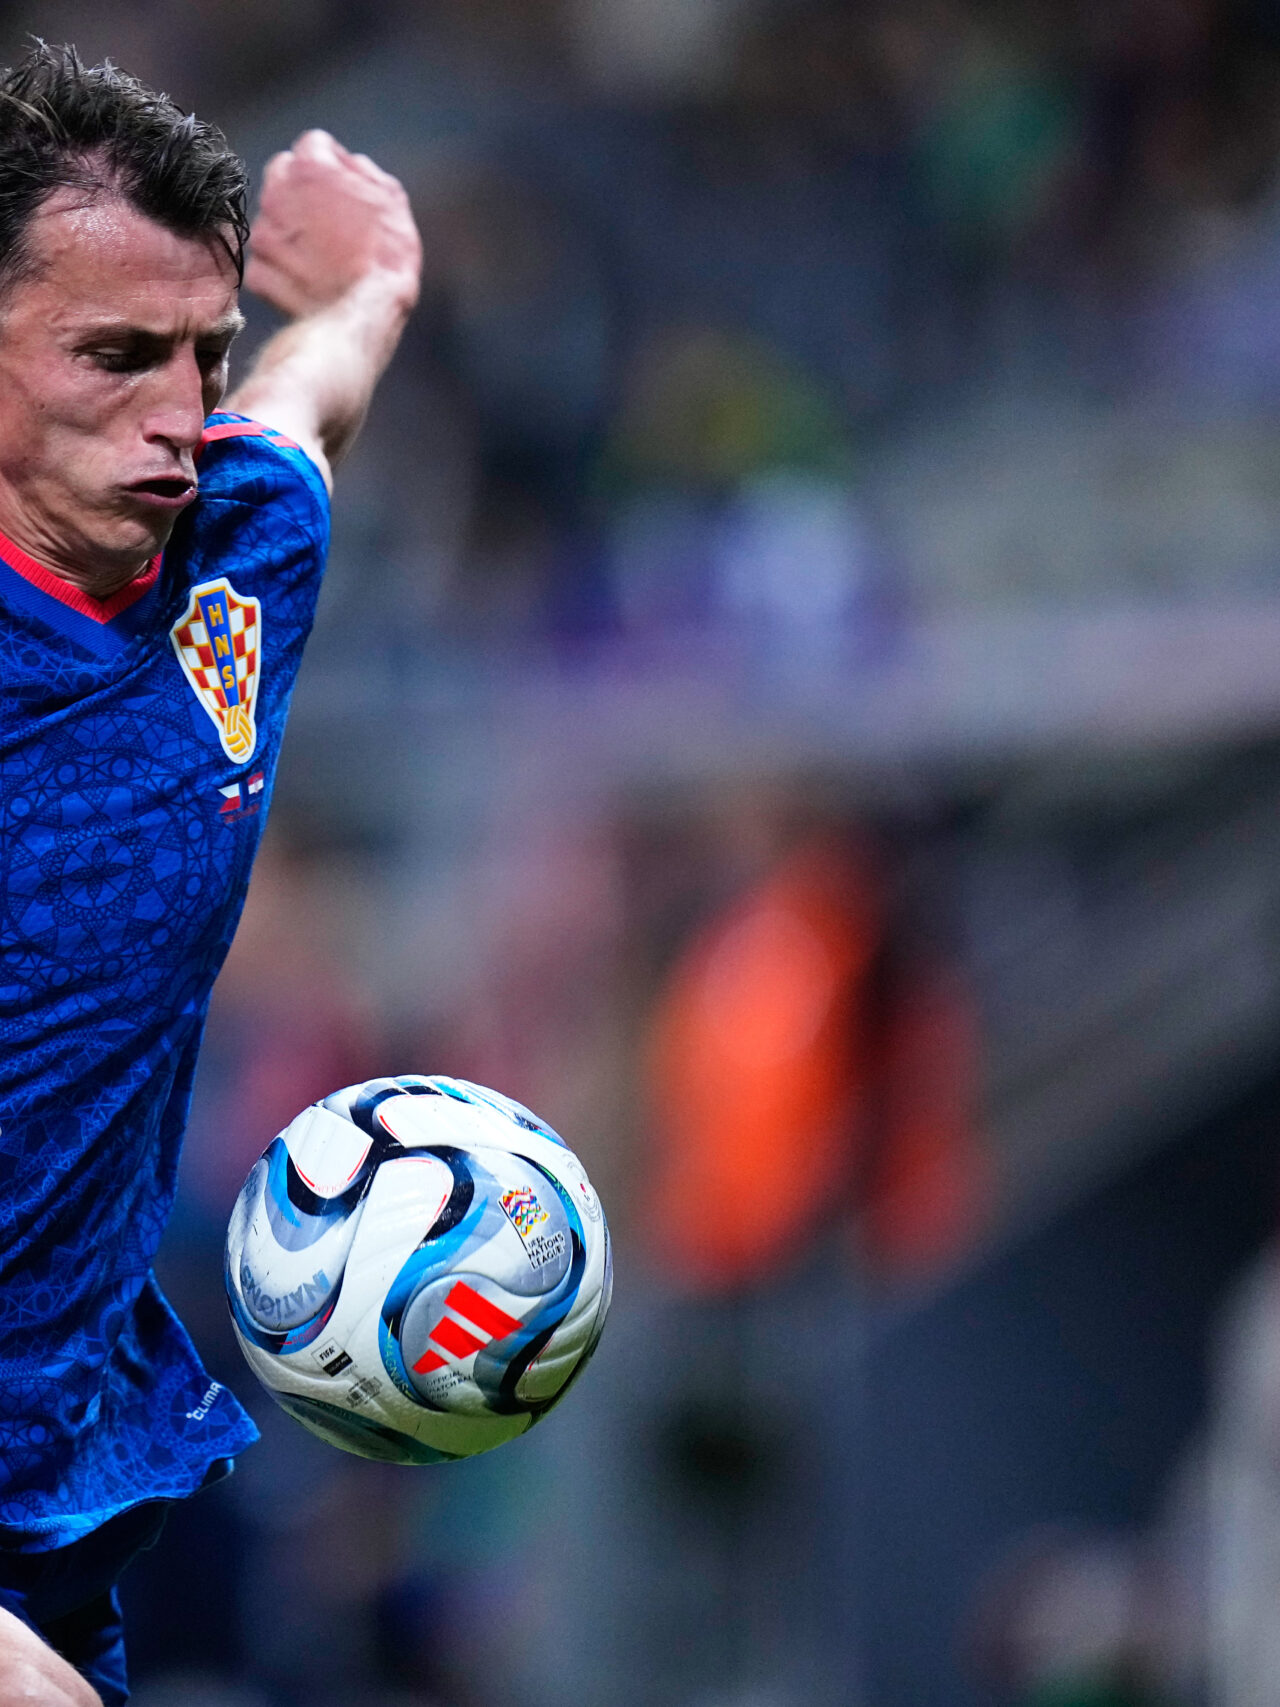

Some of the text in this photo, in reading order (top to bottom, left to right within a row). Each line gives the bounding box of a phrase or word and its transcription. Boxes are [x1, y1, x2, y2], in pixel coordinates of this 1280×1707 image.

[207, 603, 236, 690] HNS
[529, 1233, 564, 1260] NATIONS
[531, 1245, 562, 1270] LEAGUE
[319, 1346, 335, 1361] FIFA
